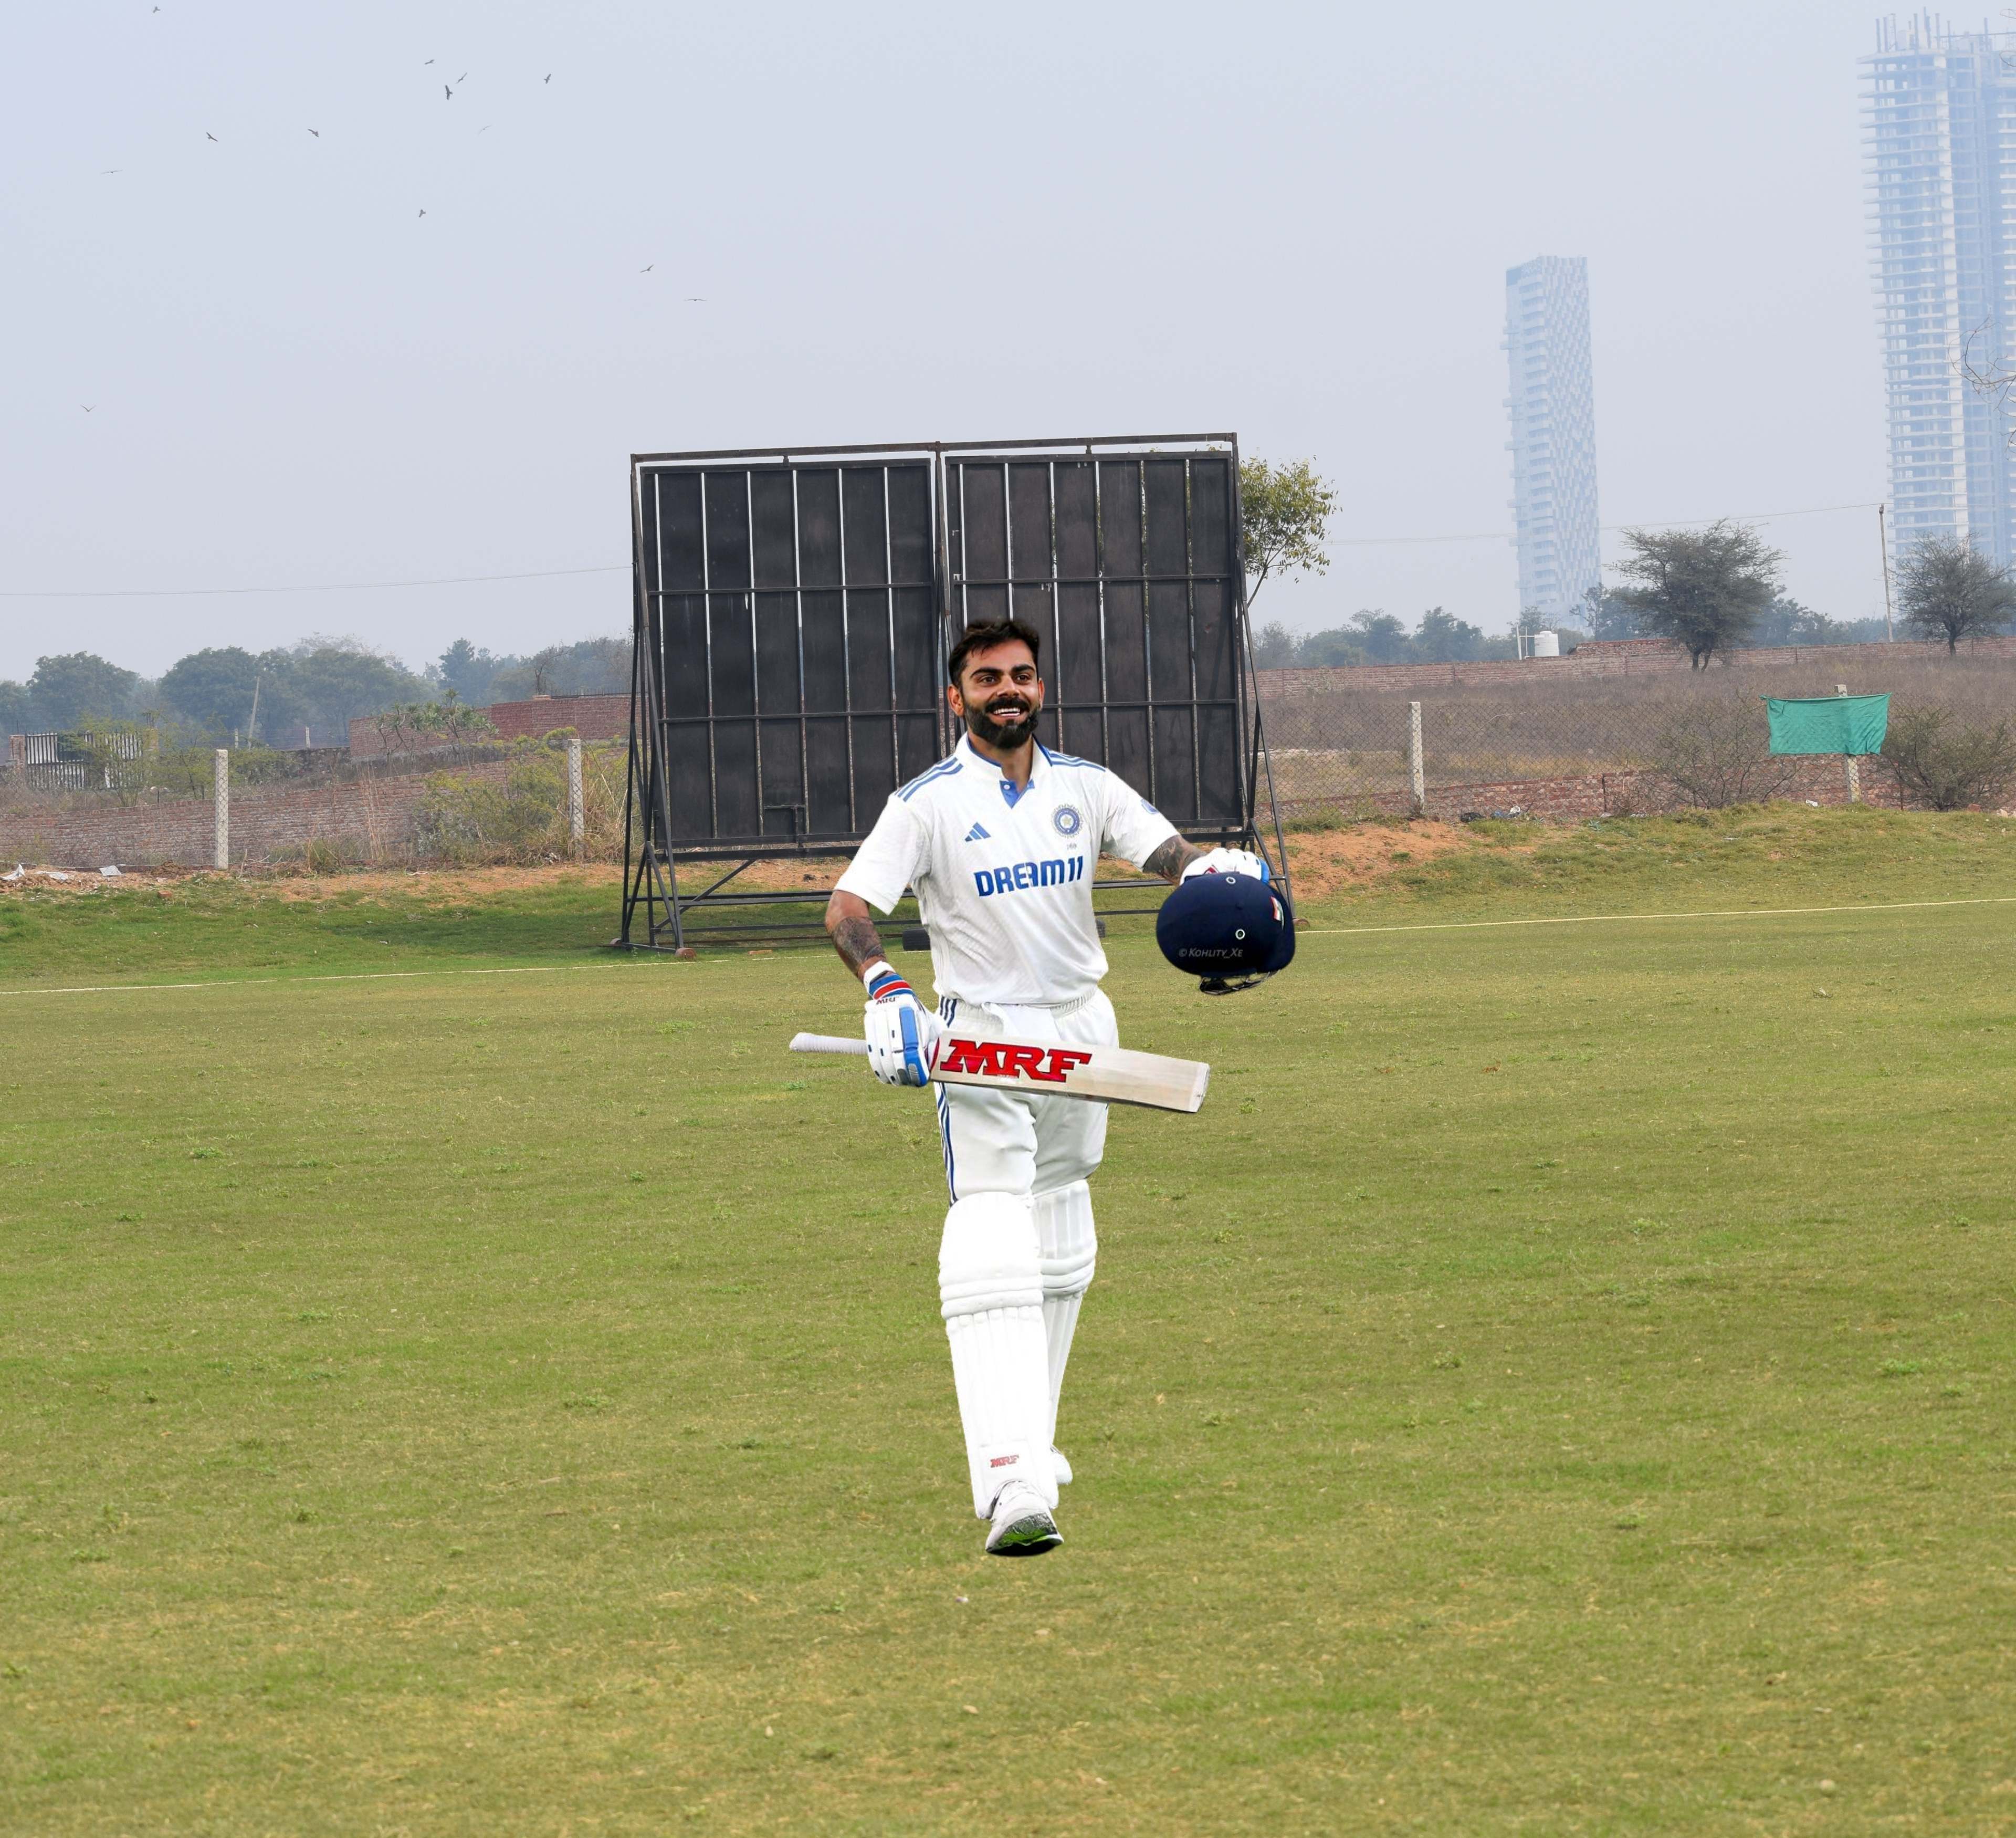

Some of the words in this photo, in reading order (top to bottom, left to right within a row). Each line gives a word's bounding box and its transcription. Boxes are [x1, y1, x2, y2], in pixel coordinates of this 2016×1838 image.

[973, 856, 1083, 896] DREAM11
[940, 1039, 1092, 1082] MRF
[990, 1454, 1019, 1468] MRF
